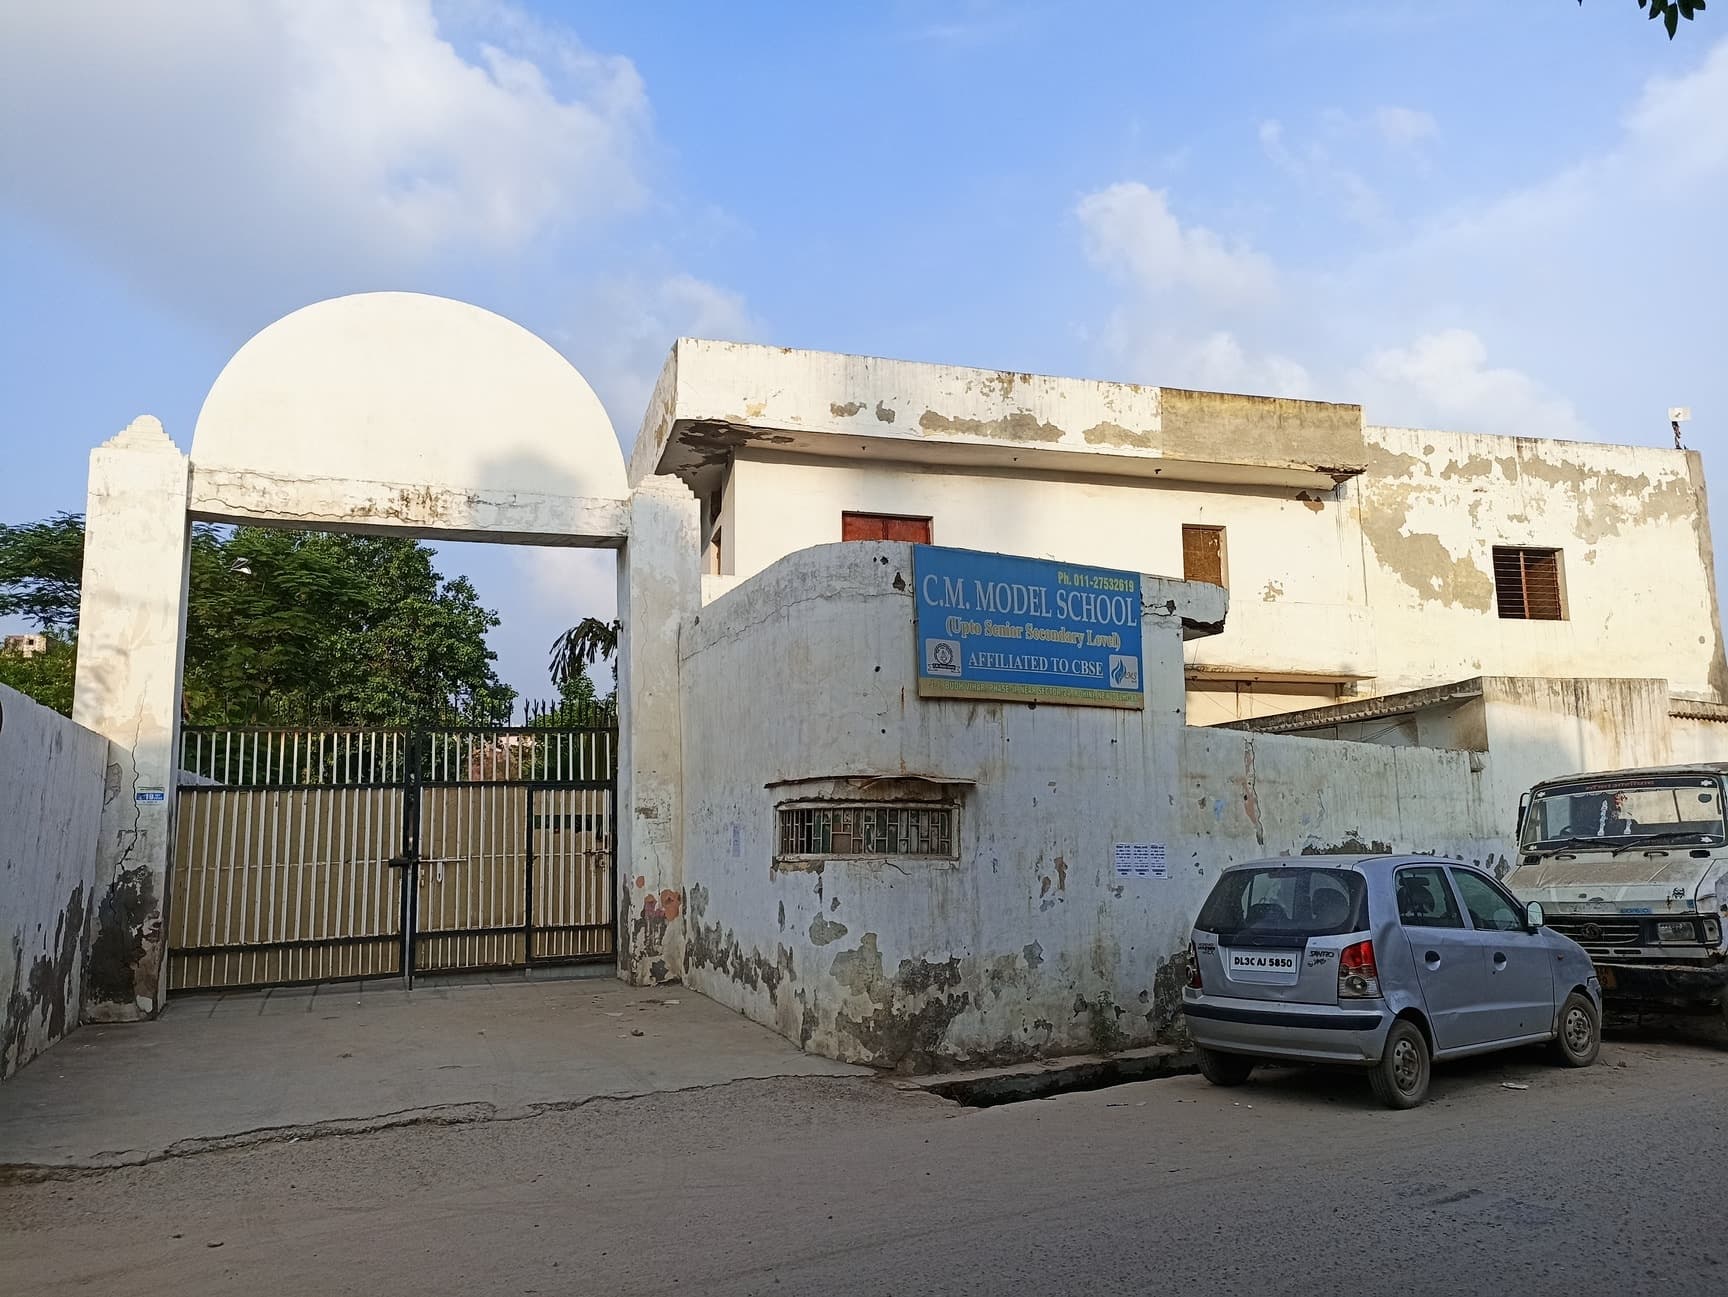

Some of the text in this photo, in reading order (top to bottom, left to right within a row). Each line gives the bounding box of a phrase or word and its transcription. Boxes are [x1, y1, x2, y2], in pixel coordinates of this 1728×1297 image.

[1057, 571, 1135, 593] Ph. 011-27532619
[923, 574, 1137, 627] C.M. MODEL SCHOOL
[945, 616, 1121, 652] (Upto Senior Secondary Level)
[968, 651, 1048, 671] AFFILIATED
[1050, 657, 1069, 673] TO
[1071, 659, 1104, 676] CBSE
[1234, 956, 1293, 968] DL3C AJ 5850
